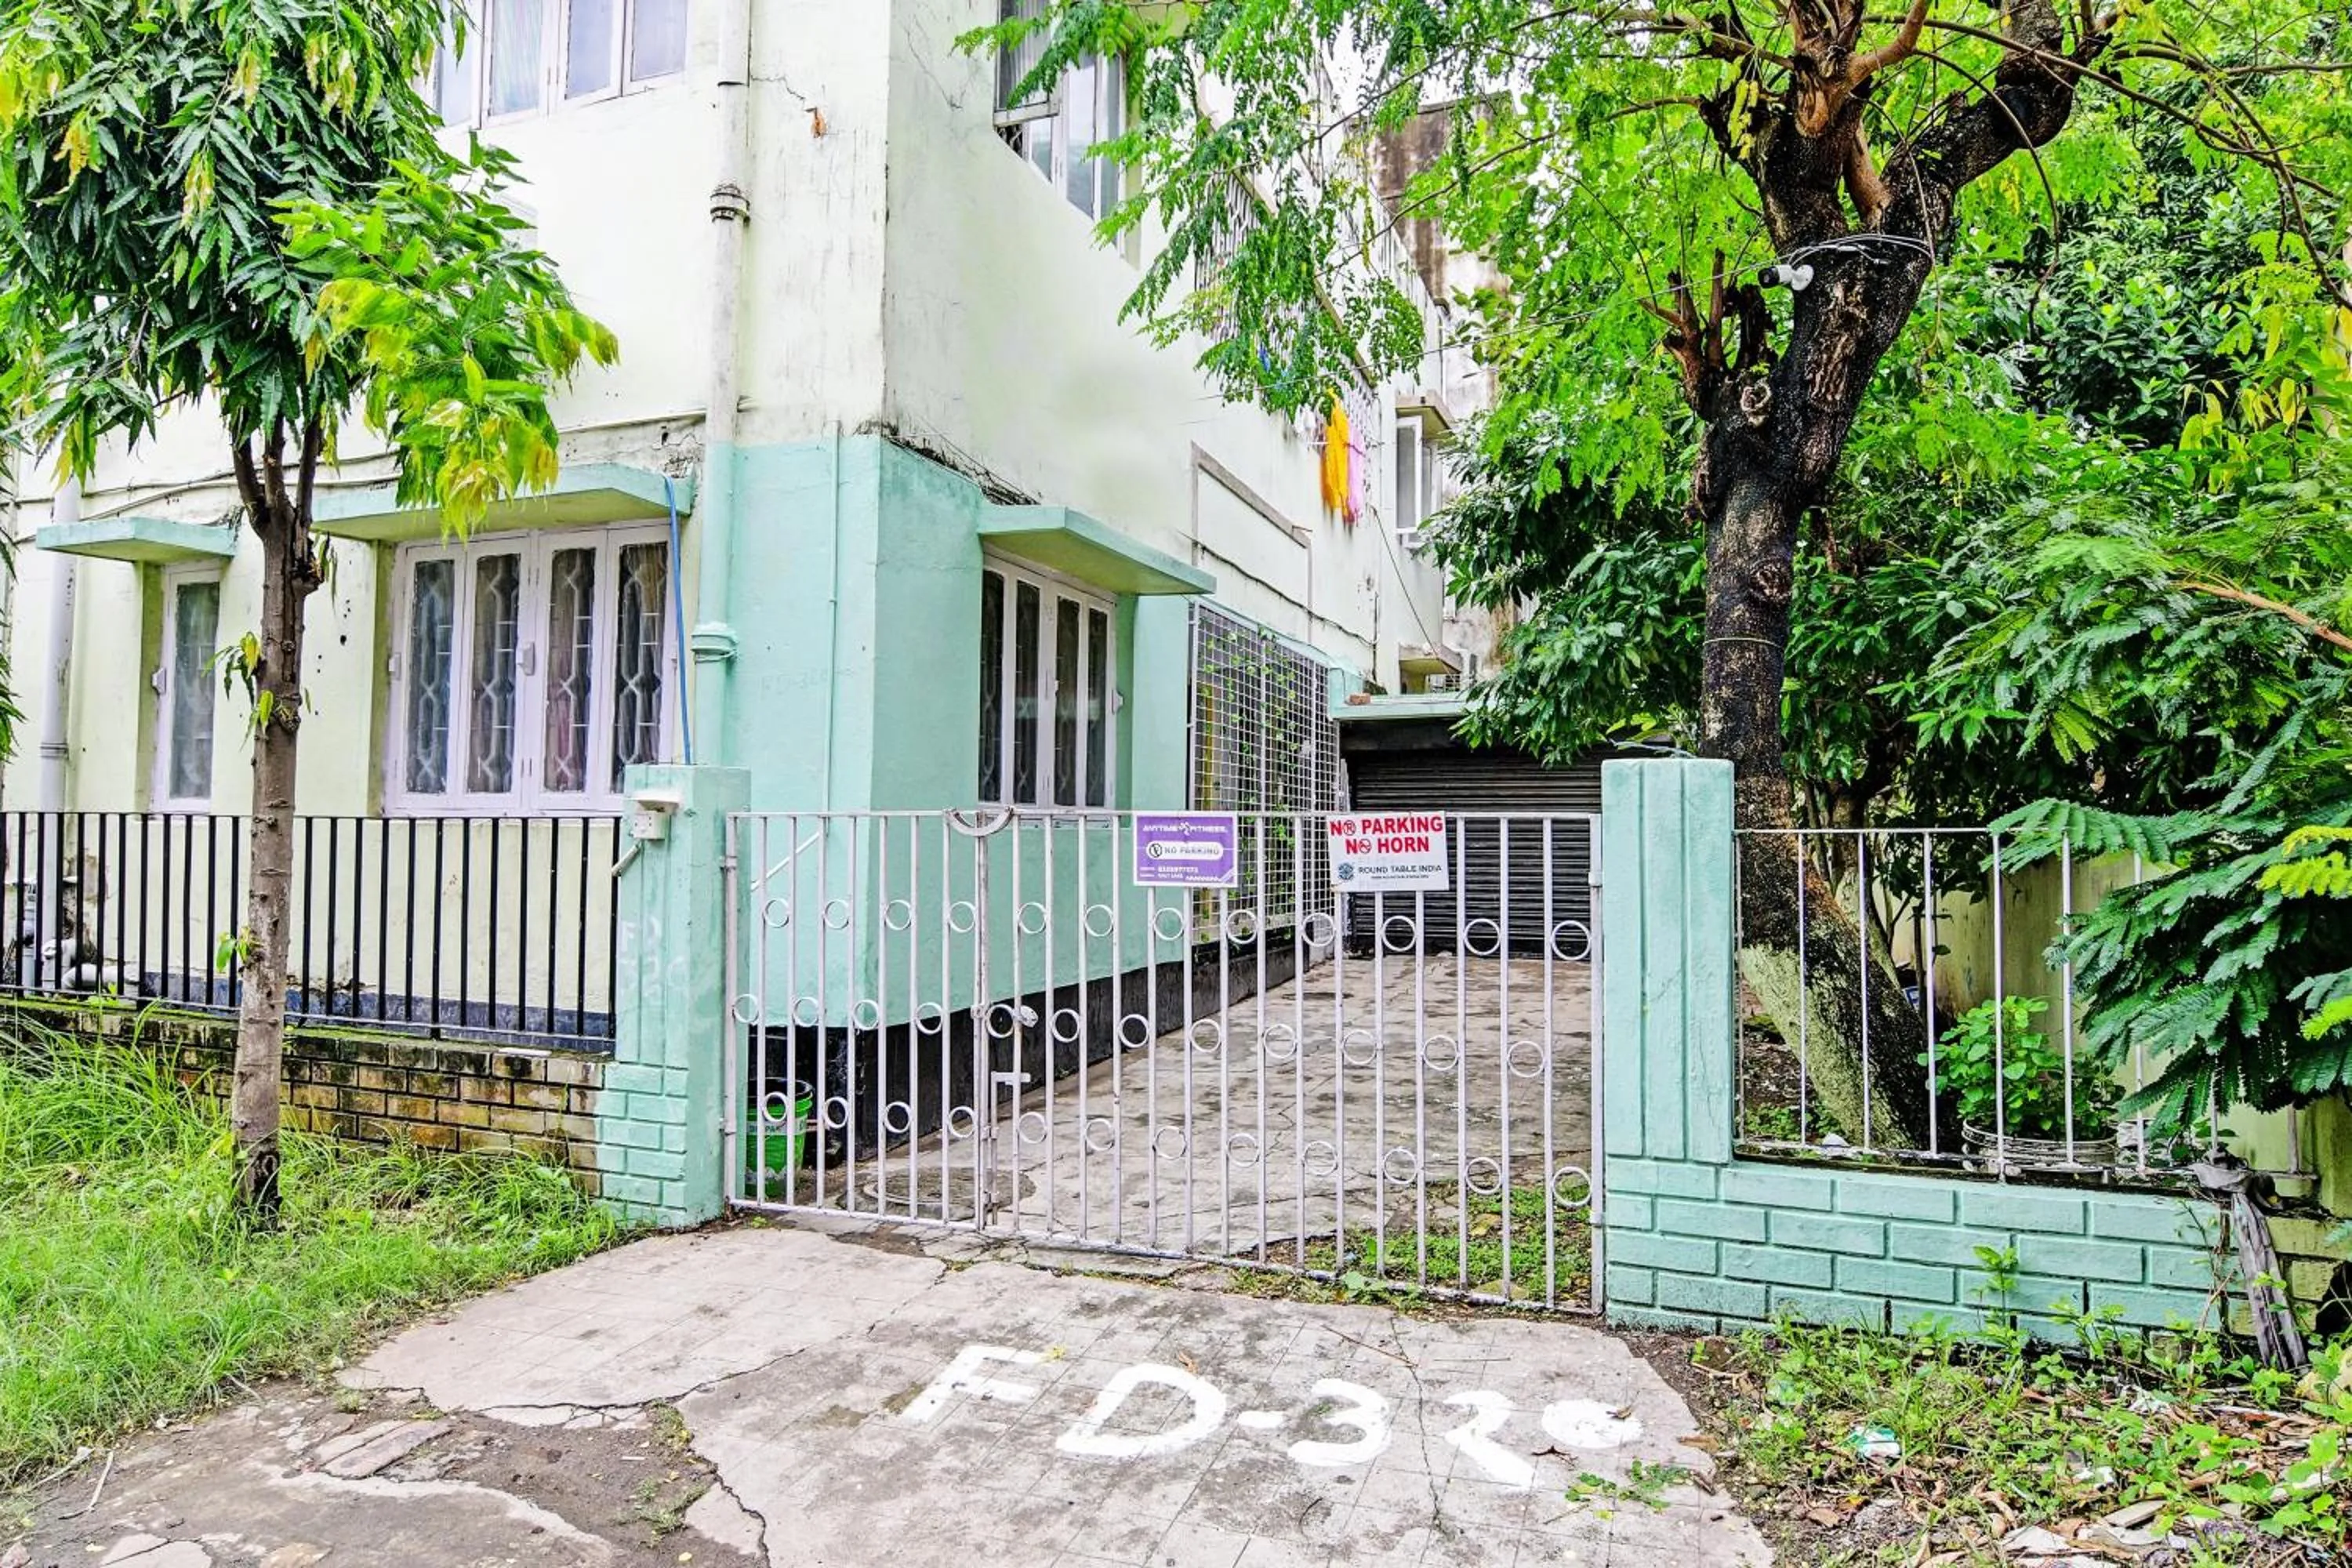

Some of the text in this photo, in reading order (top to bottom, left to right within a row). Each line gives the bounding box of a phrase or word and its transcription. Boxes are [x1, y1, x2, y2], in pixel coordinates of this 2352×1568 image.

[1361, 816, 1443, 835] PARKING
[1377, 836, 1430, 854] HORN
[1358, 865, 1388, 874] ROUND
[1418, 864, 1442, 873] INDIA
